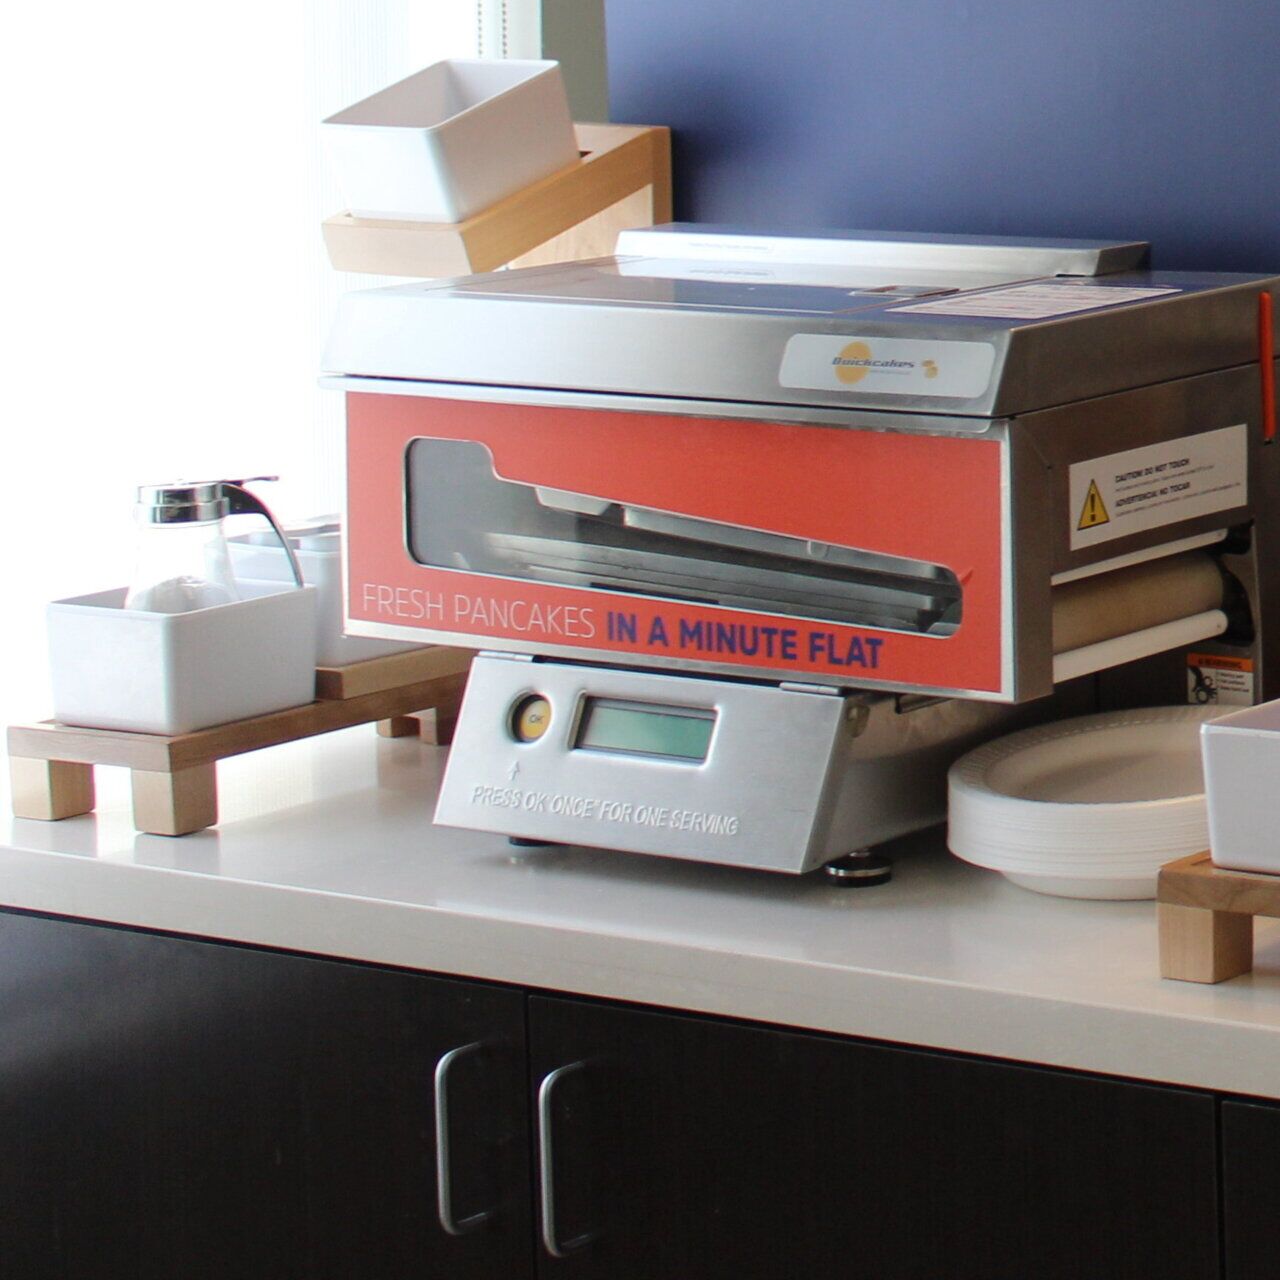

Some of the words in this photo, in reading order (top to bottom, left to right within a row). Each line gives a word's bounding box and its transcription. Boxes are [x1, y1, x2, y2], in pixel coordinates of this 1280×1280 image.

[362, 583, 444, 621] FRESH
[454, 593, 596, 639] PANCAKES
[606, 611, 638, 643] IN
[647, 619, 669, 648] A
[679, 622, 798, 661] MINUTE
[807, 631, 884, 670] FLAT
[529, 713, 544, 725] OK
[471, 785, 520, 809] PRESS
[524, 791, 545, 812] OK
[599, 800, 632, 822] FOR
[634, 805, 668, 827] ONE
[670, 809, 739, 837] SERVING
